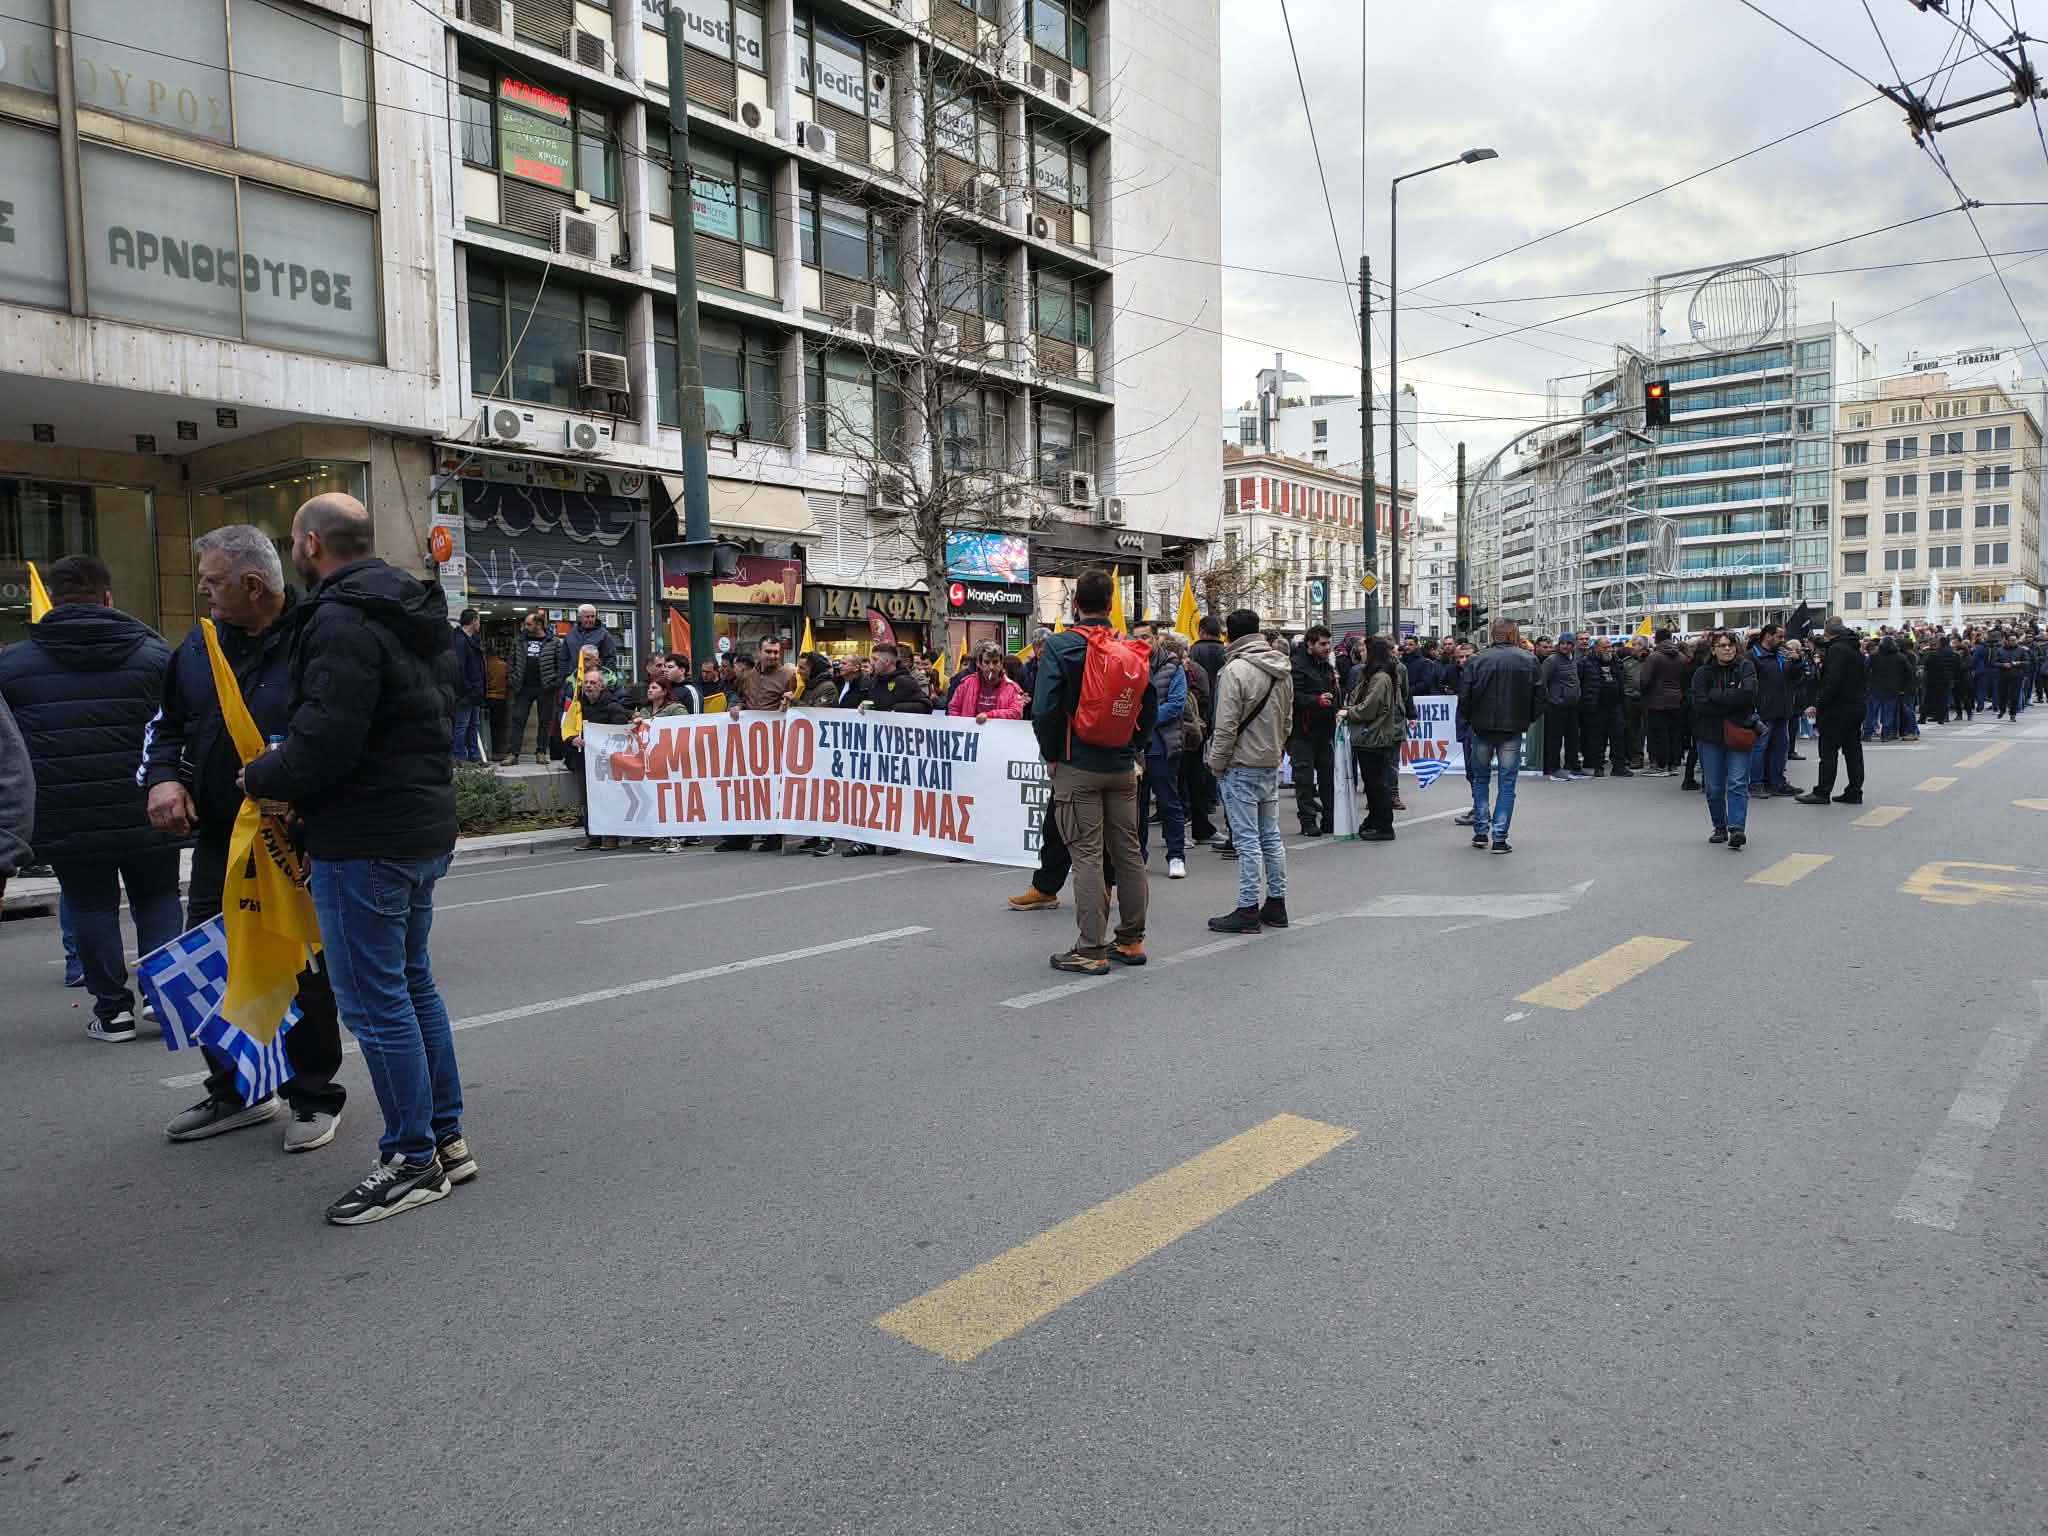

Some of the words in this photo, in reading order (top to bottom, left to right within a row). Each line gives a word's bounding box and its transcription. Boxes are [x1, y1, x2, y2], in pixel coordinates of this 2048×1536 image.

[799, 55, 880, 109] Medica
[108, 225, 353, 311] ΑΡΝΟΚΟΥΡΟΣ
[968, 588, 1021, 605] MoneyGram
[819, 720, 867, 751] ΣΤΗΝ
[873, 724, 979, 762] ΚΥΒΕΡΝΗΣΗ
[831, 750, 843, 778] &
[850, 751, 872, 781] ΤΗ
[878, 753, 911, 786] ΝΕΑ
[918, 757, 952, 791] ΚΑΠ
[656, 781, 706, 824] ΓΙΑ
[716, 778, 771, 822] ΤΗΝ
[777, 777, 903, 833] ΠΙΒΙΩΣΗ
[913, 789, 975, 844] ΜΑΣ
